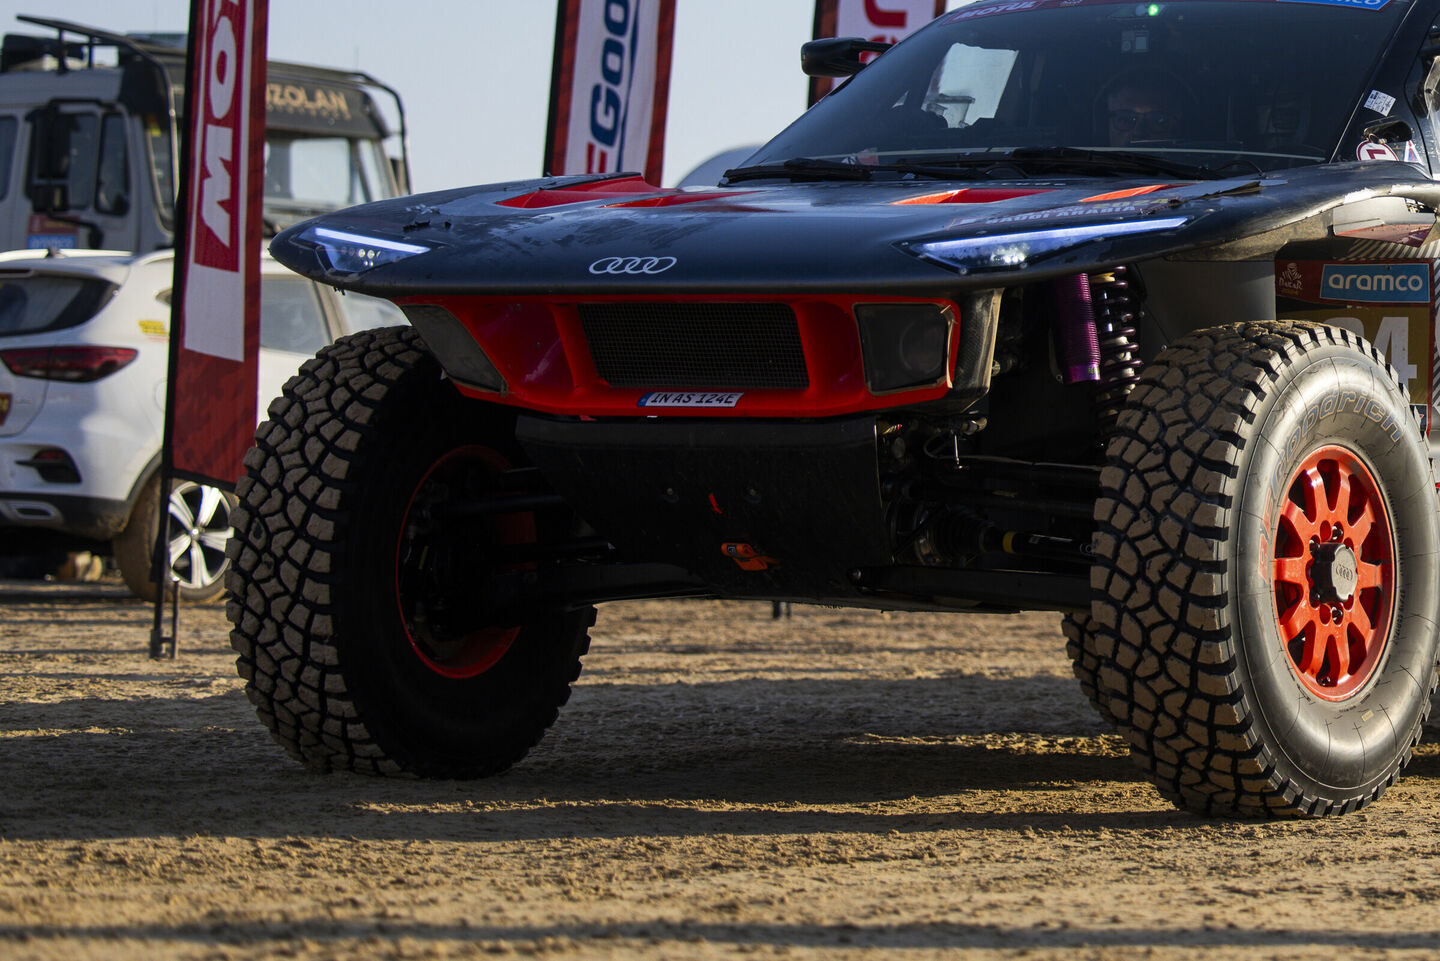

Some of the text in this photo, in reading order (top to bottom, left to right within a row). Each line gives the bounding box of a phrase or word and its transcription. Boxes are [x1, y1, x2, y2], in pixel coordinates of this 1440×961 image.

[1328, 273, 1424, 292] aramco
[651, 393, 736, 404] IN AS 124E
